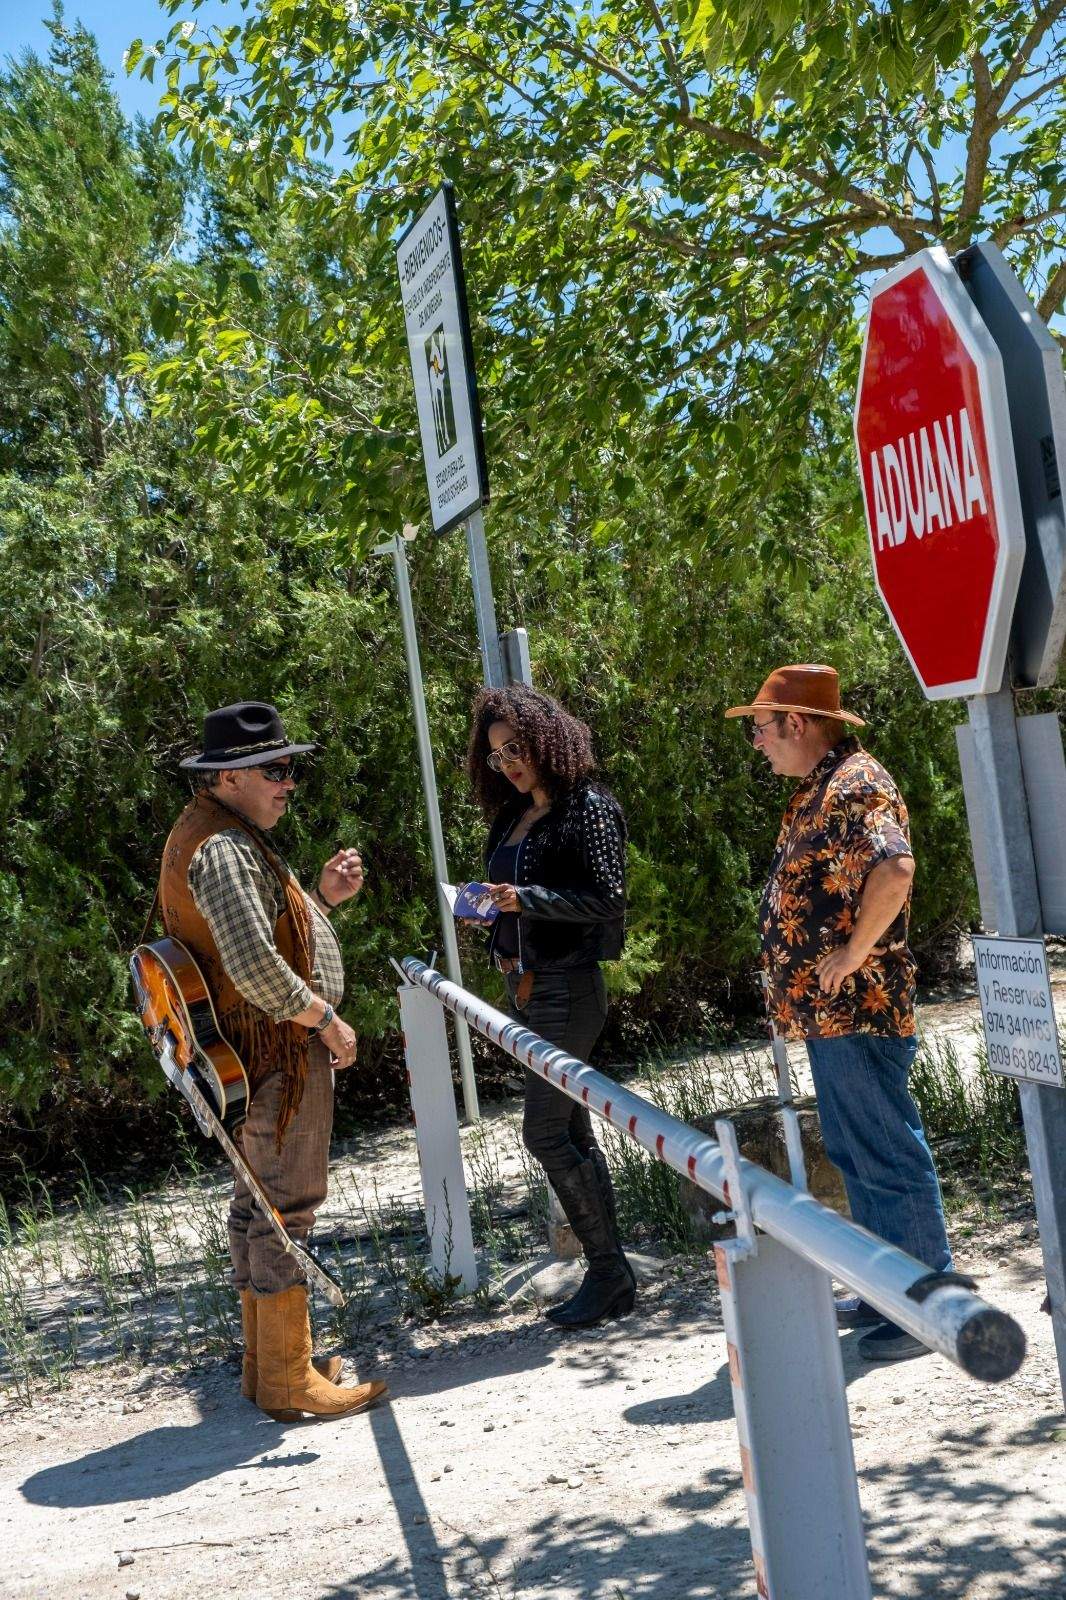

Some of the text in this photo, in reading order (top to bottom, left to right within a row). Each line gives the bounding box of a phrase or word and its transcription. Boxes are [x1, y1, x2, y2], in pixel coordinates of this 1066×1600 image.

[871, 408, 987, 551] ADUANA
[977, 948, 1043, 974] Información
[983, 980, 1047, 1008] y Reservas
[987, 1012, 1005, 1033] 974
[990, 1043, 1011, 1066] 609
